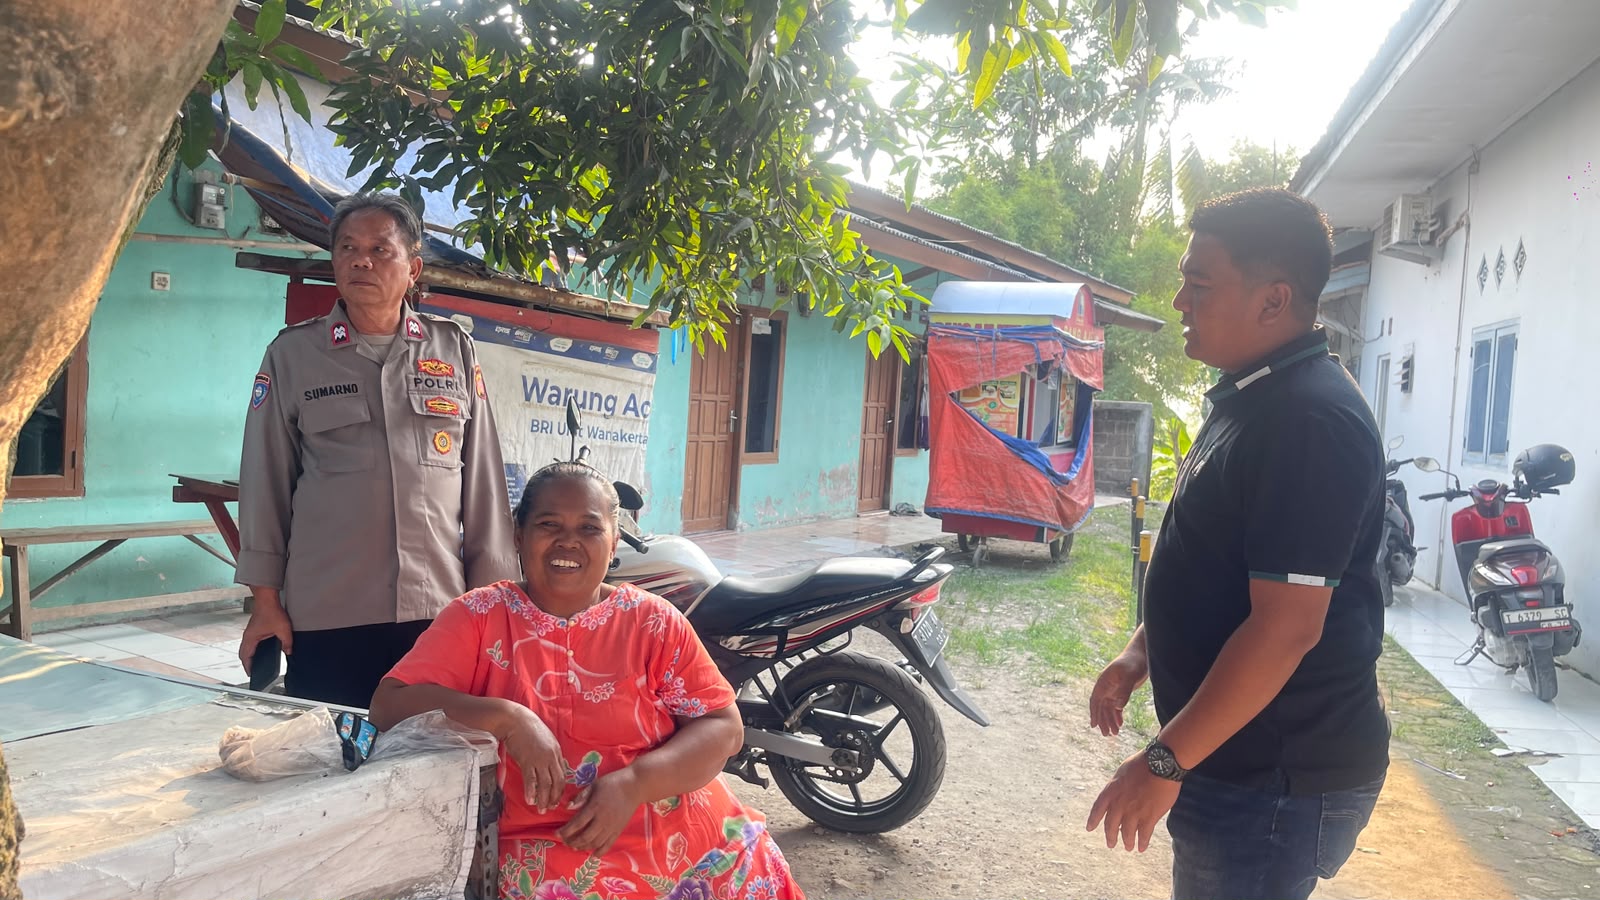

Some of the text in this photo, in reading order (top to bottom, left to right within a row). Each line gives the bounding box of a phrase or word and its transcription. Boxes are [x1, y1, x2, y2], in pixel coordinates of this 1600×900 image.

[304, 383, 359, 401] SUMARNO
[414, 377, 459, 391] POLRI
[521, 374, 618, 419] Warung
[530, 418, 649, 445] BRI Ut Wanakerta
